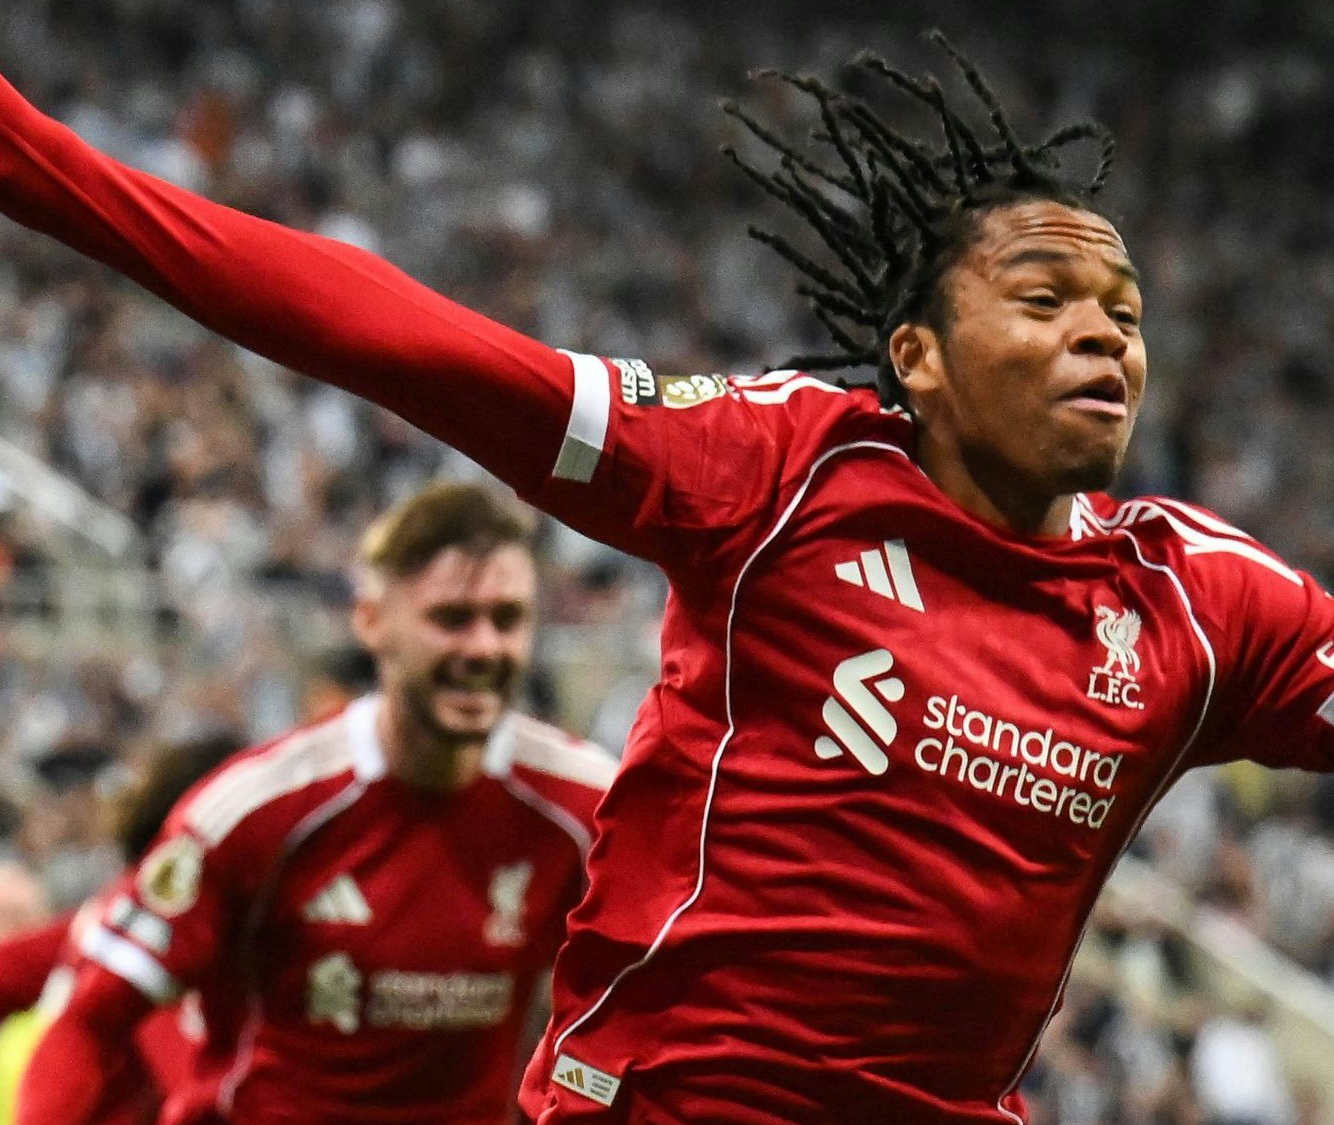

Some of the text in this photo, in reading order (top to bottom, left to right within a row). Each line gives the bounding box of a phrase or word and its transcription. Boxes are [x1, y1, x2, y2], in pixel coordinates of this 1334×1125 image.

[1087, 673, 1145, 710] L.F.C.
[914, 736, 1116, 829] chartered
[923, 694, 1123, 789] standard
